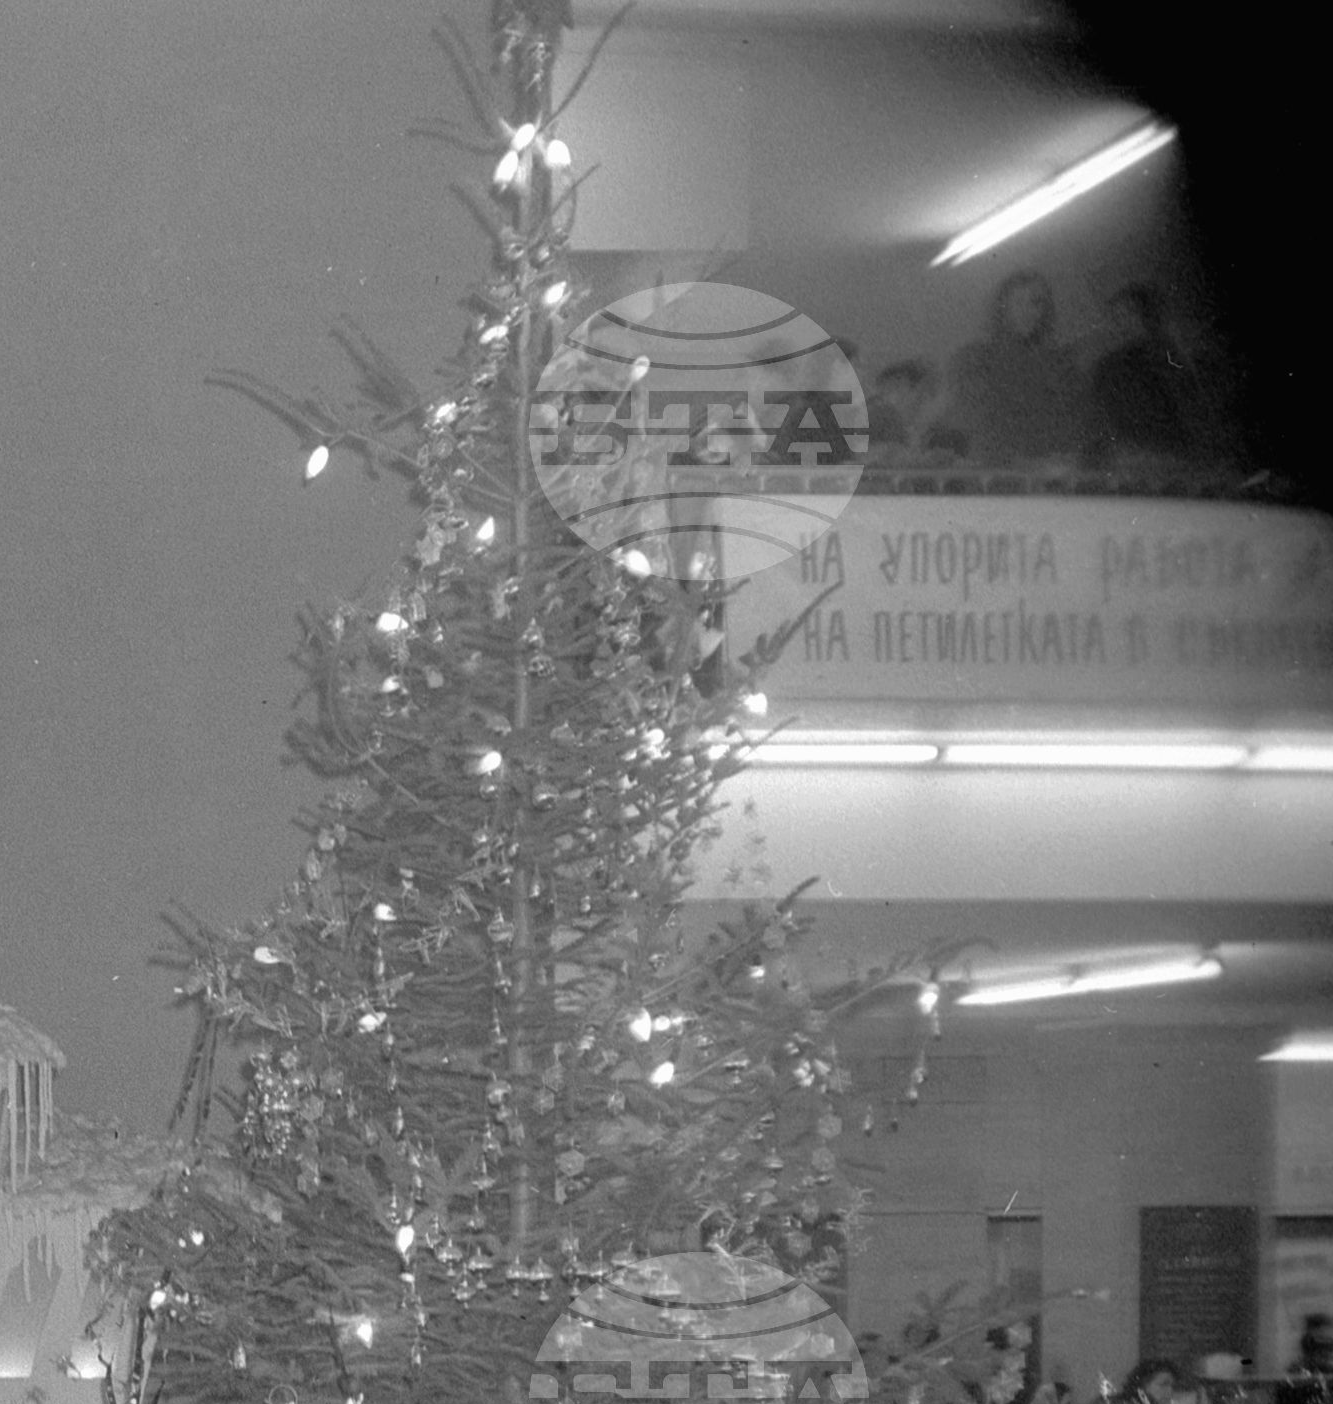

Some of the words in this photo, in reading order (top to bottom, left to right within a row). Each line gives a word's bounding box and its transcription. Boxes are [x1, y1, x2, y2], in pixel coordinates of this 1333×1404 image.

[879, 531, 1058, 602] УПОРИТА
[804, 607, 850, 662] НА
[873, 598, 1107, 664] ПЕТИЛЕТКАТА
